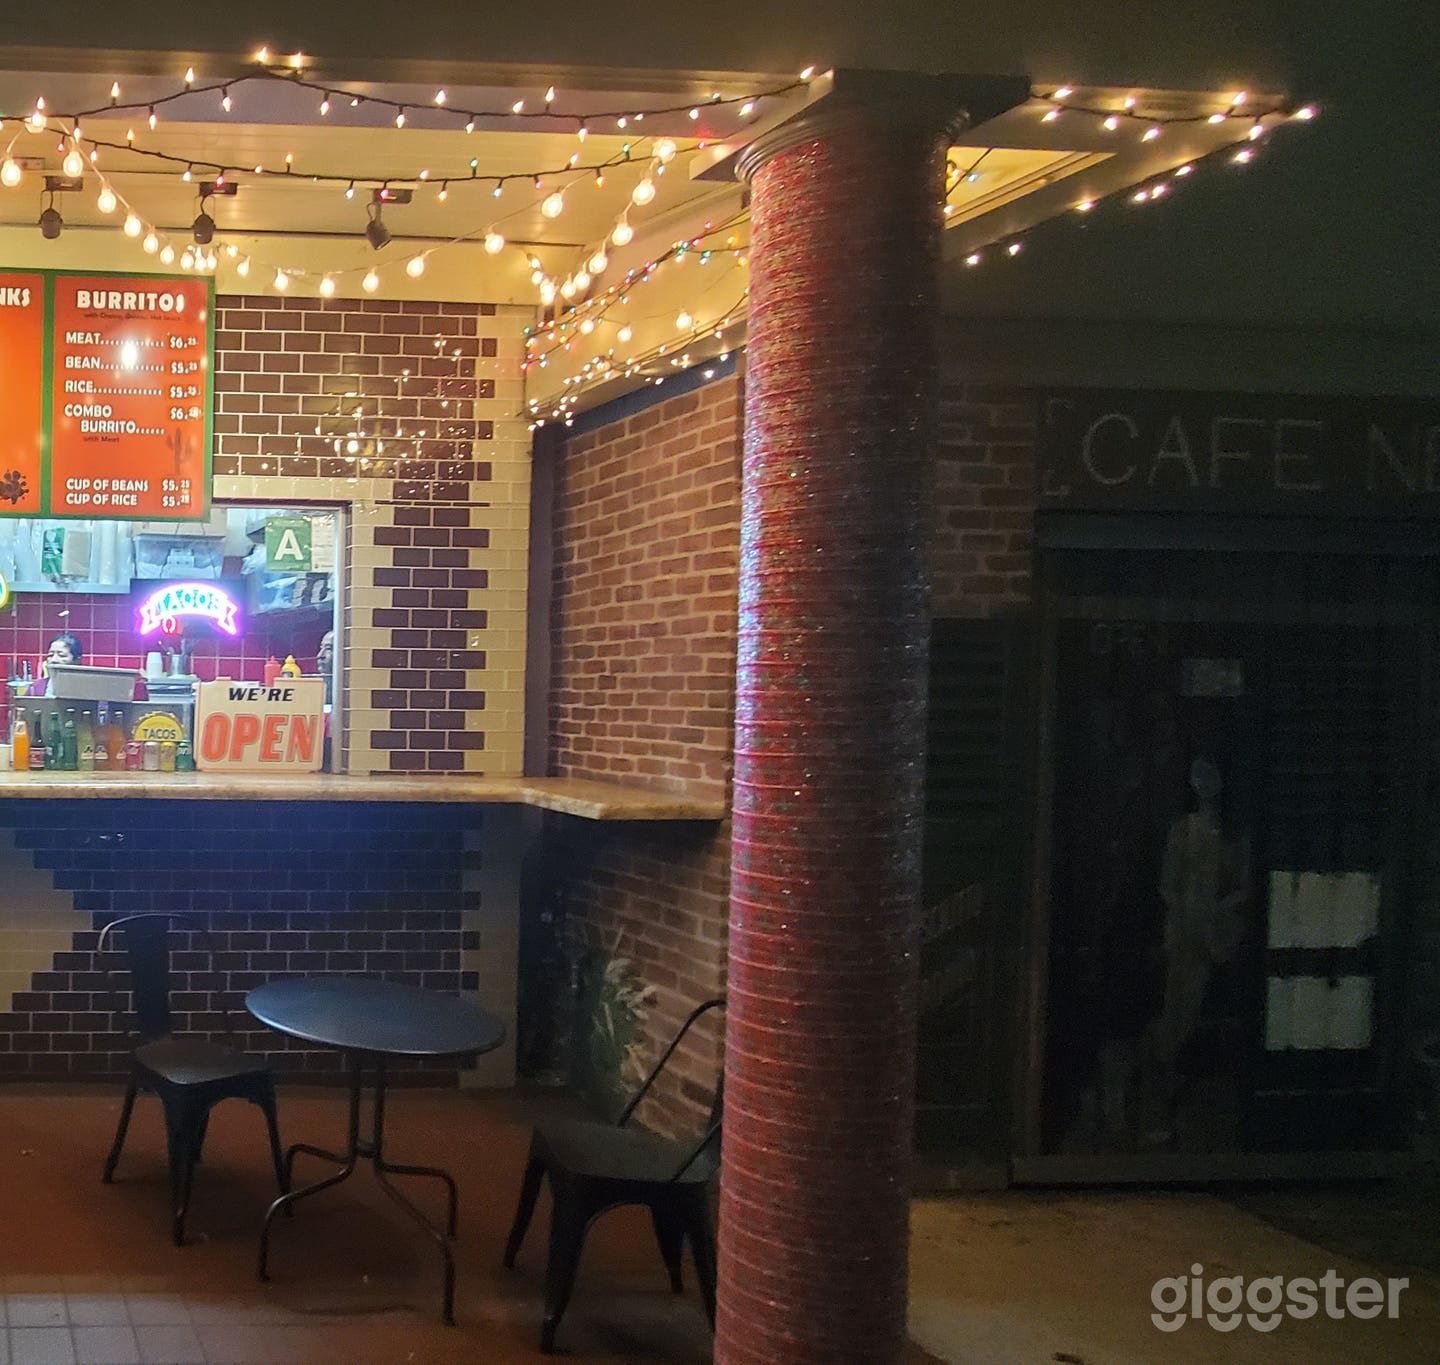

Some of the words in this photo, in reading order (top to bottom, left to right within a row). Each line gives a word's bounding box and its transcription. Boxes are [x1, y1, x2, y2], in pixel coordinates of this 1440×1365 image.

[76, 290, 185, 313] BURRITOS
[64, 403, 112, 418] COMBO
[1080, 412, 1324, 491] CAFE
[66, 478, 90, 492] CUP
[93, 479, 109, 492] OF
[112, 479, 149, 493] BEANS
[66, 493, 90, 505] CUP
[93, 493, 109, 505] OF
[111, 493, 137, 506] RICE
[273, 528, 305, 561] A
[228, 687, 295, 702] WE'RE
[142, 727, 177, 740] TACOS
[201, 711, 319, 763] OPEN
